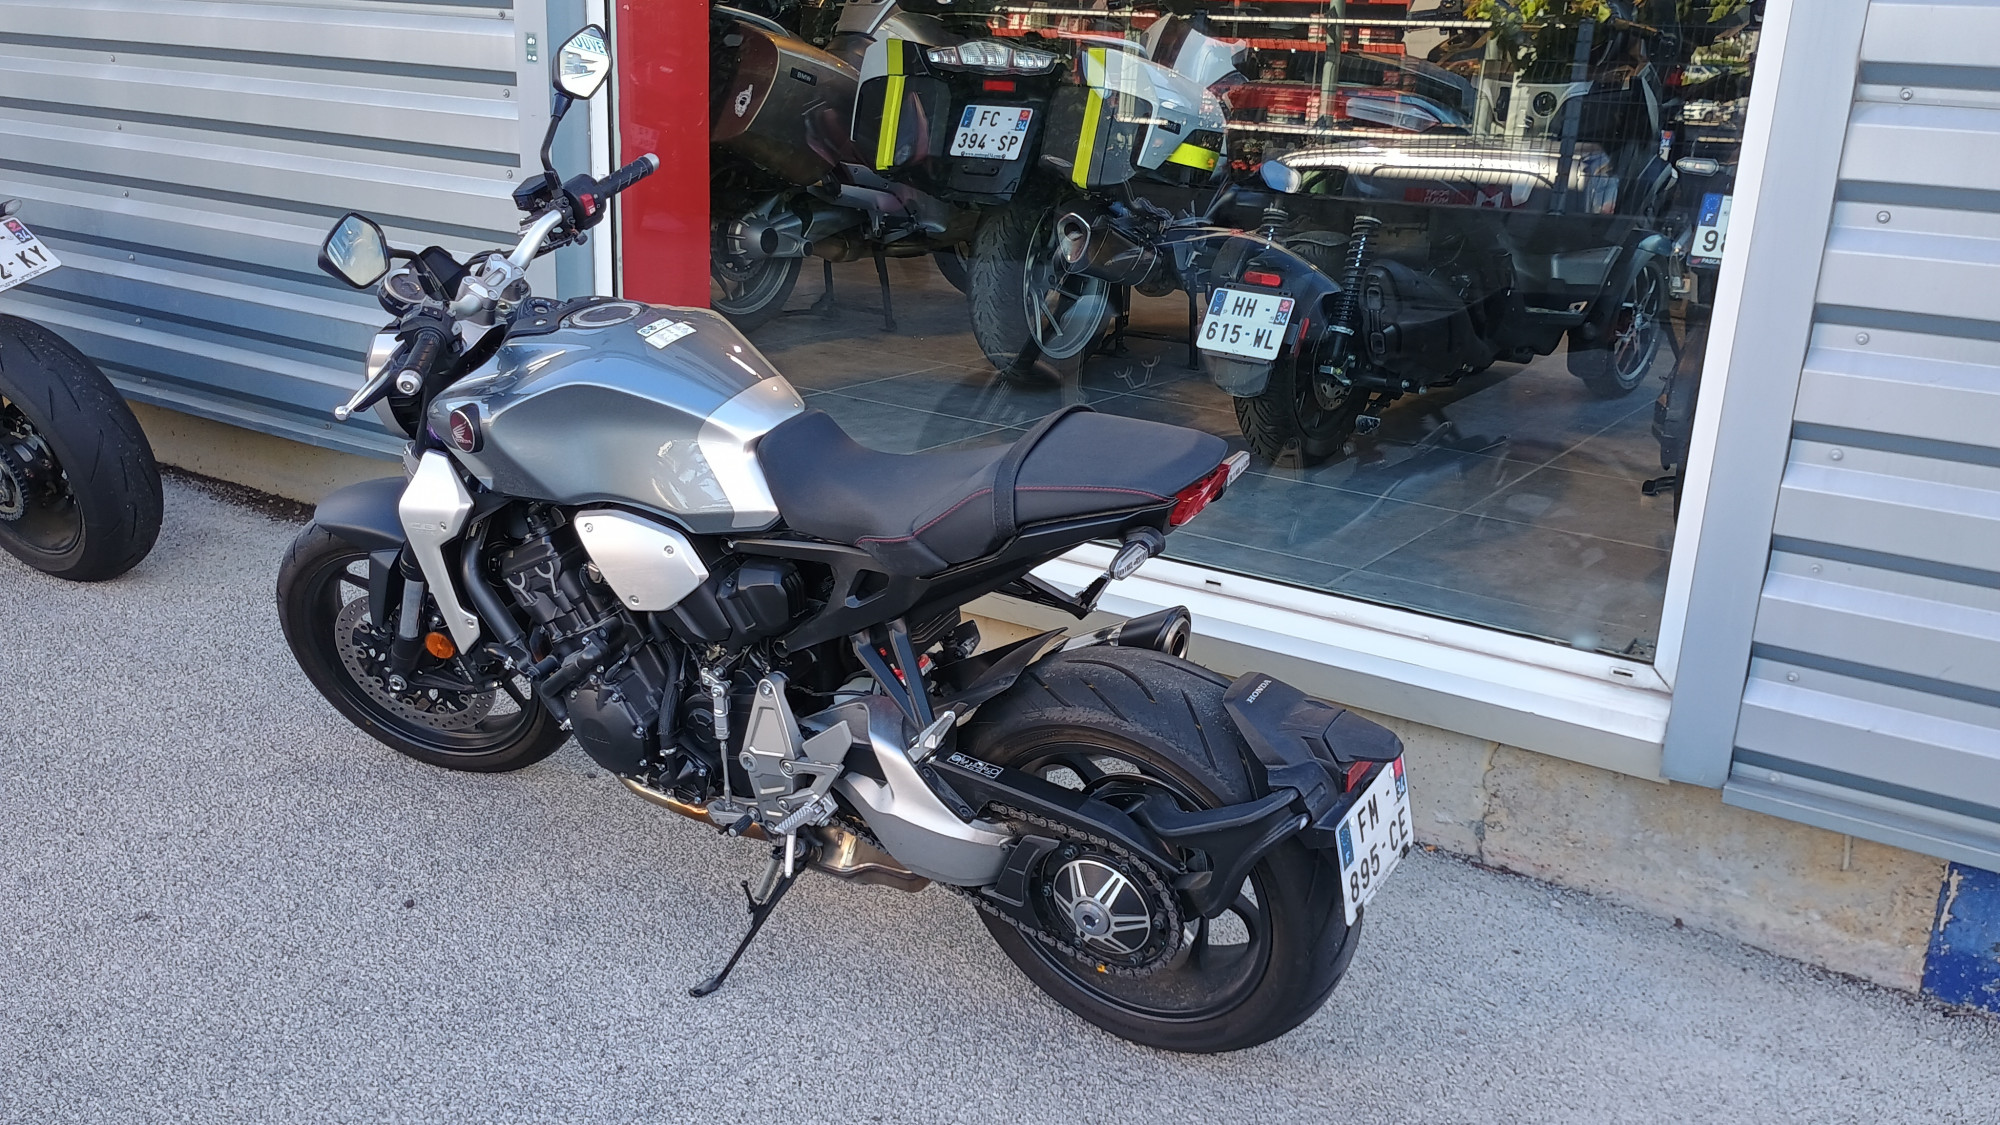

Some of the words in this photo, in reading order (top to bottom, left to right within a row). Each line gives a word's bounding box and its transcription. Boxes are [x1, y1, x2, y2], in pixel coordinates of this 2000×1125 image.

[979, 111, 1001, 128] FC
[1015, 121, 1027, 130] 34
[1705, 213, 1714, 222] F
[1702, 229, 1726, 253] 9
[1701, 257, 1720, 265] PASCA
[1231, 296, 1258, 318] HH
[1275, 312, 1287, 324] 34
[1246, 679, 1272, 704] HONDA
[1394, 775, 1406, 800] 34
[1357, 793, 1380, 844] FM
